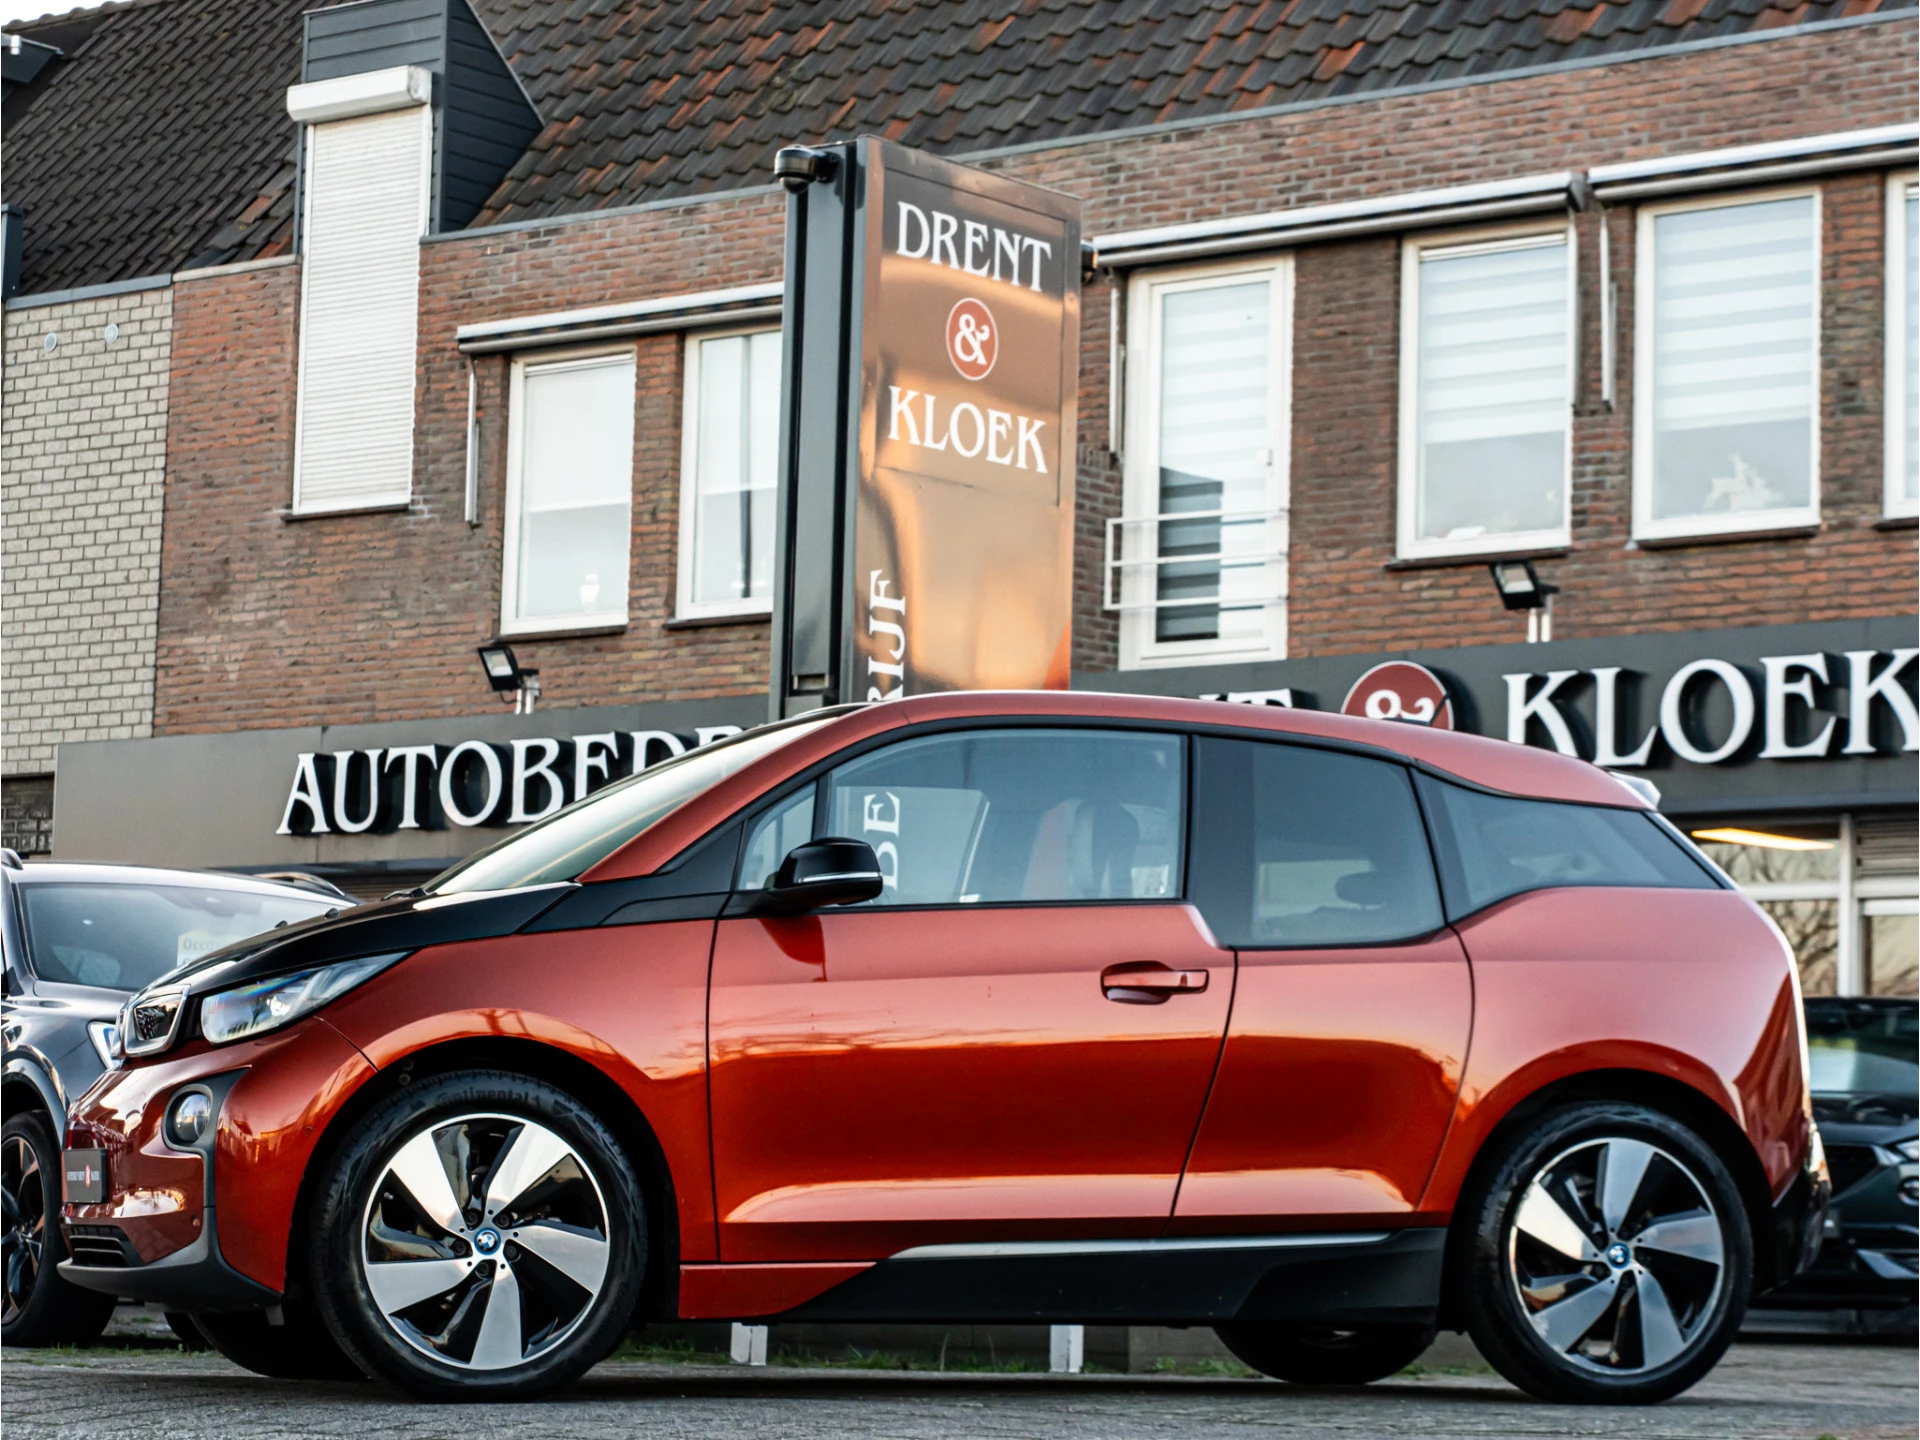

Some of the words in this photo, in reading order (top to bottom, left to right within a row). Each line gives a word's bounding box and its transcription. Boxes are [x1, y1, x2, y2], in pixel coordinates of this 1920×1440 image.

[896, 201, 1052, 292] DRENT
[954, 313, 990, 365] &
[888, 385, 1048, 473] KLOEK
[1502, 648, 1919, 766] KLOEK
[275, 725, 743, 835] AUTOBE
